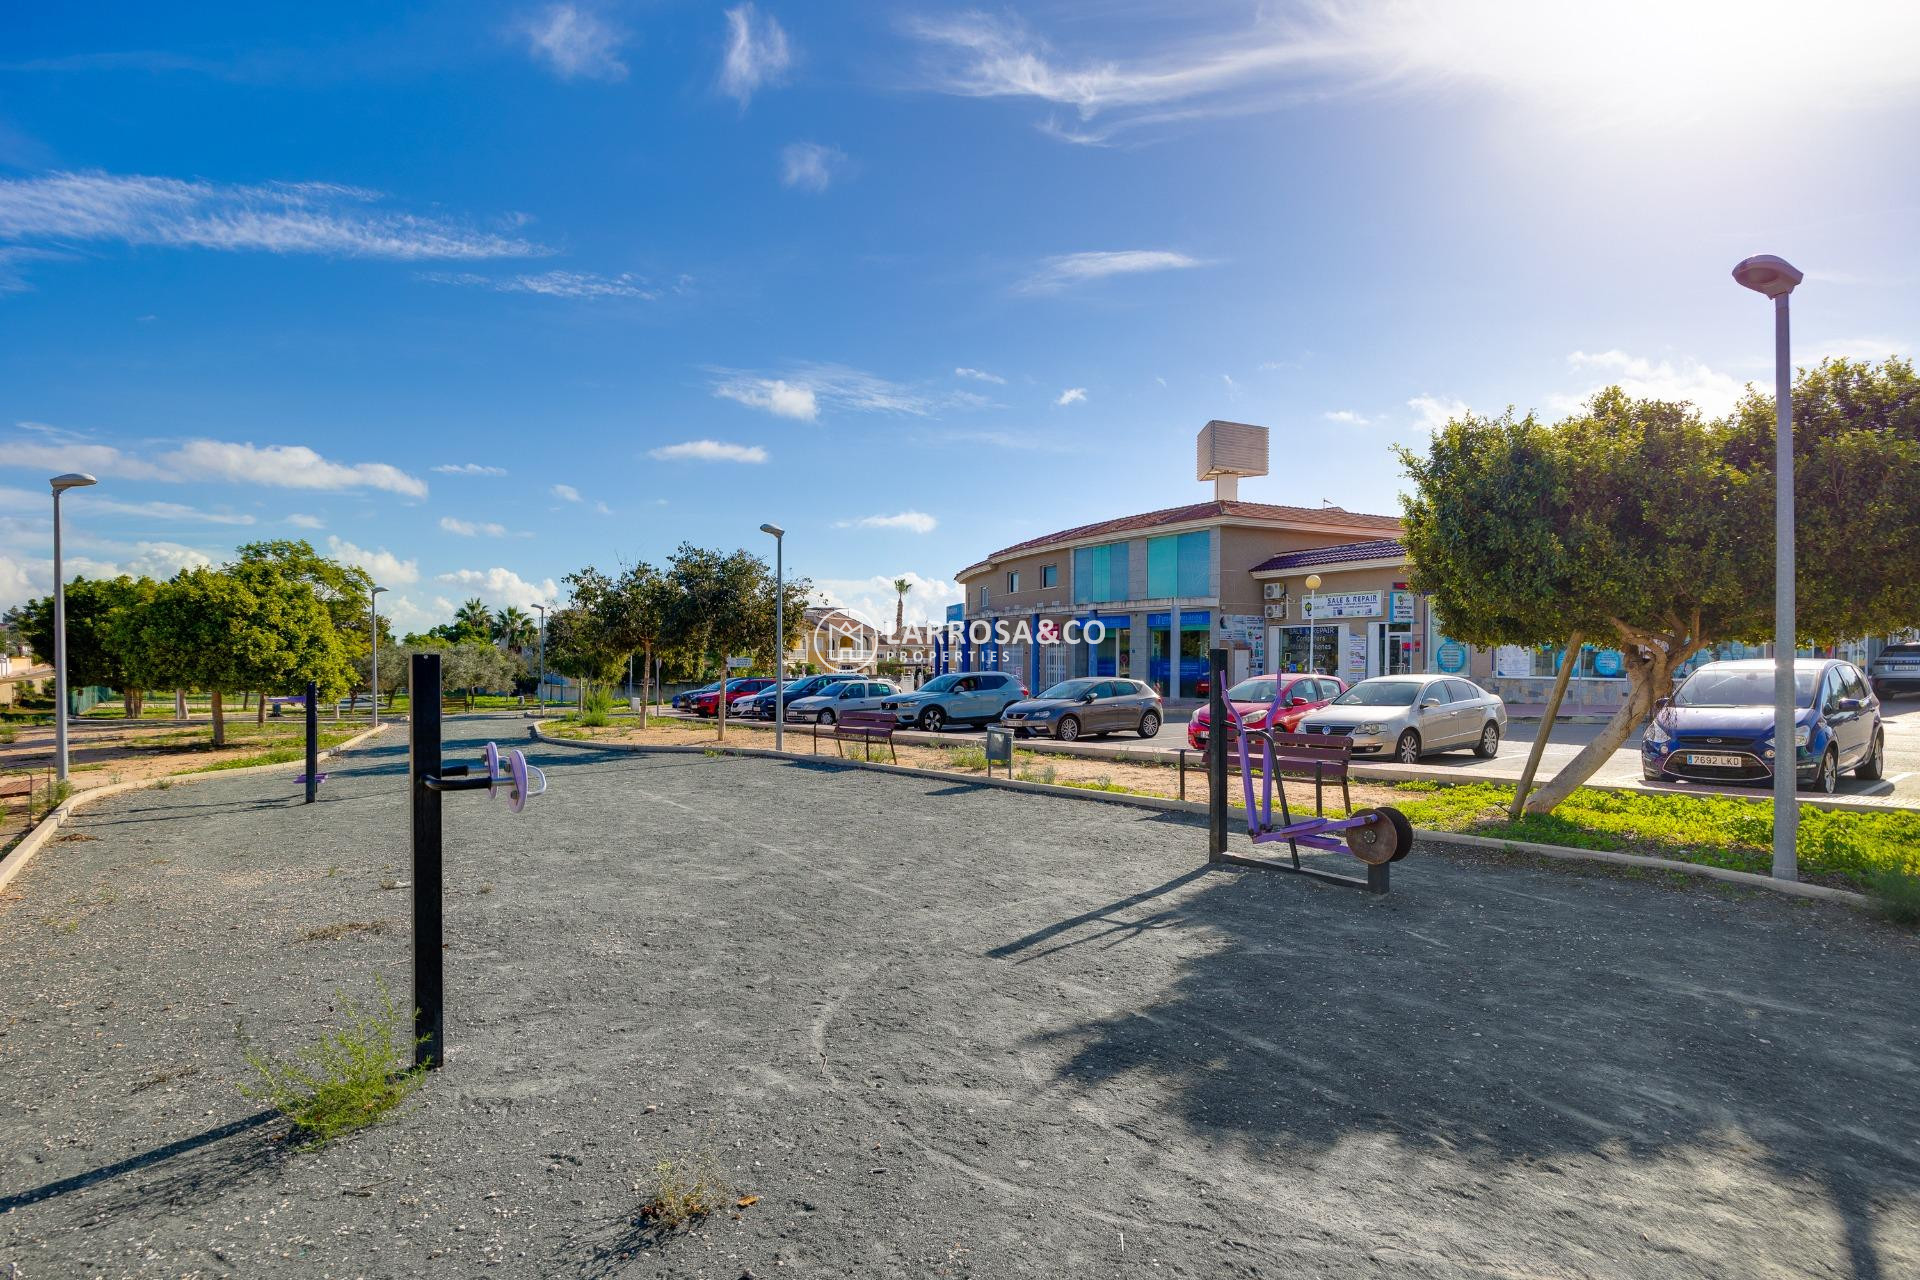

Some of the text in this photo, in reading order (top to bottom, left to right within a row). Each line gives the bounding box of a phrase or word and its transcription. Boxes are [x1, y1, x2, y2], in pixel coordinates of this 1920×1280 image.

[1327, 596, 1344, 605] SALE
[1353, 594, 1377, 603] REPAIR
[1694, 755, 1718, 765] 7692
